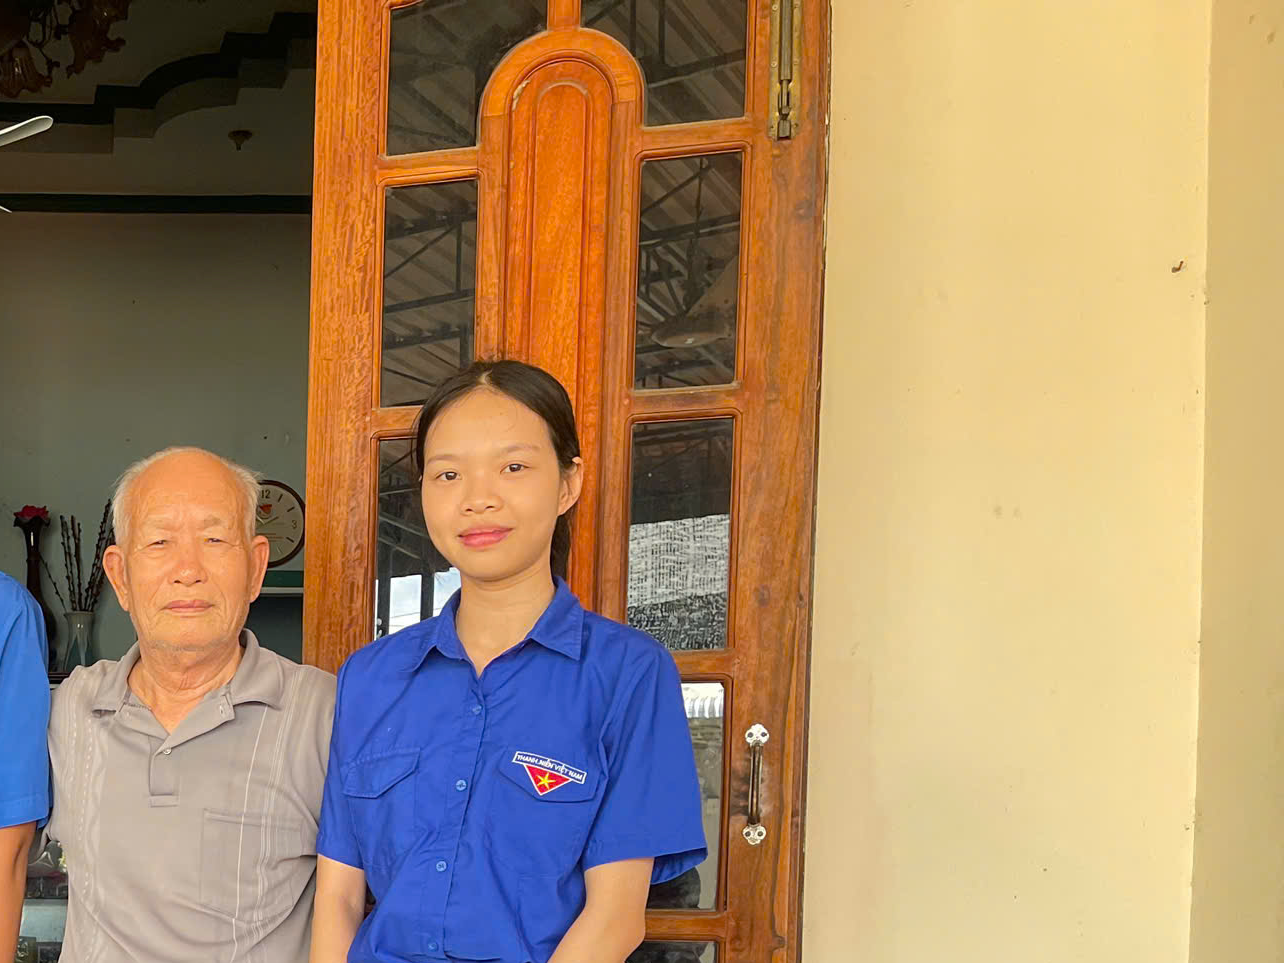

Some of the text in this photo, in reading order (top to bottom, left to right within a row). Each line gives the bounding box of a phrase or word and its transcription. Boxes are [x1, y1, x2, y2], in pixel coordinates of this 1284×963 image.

[261, 489, 271, 499] 12
[291, 520, 298, 530] 3
[517, 754, 539, 764] THANH
[568, 770, 583, 781] NAM
